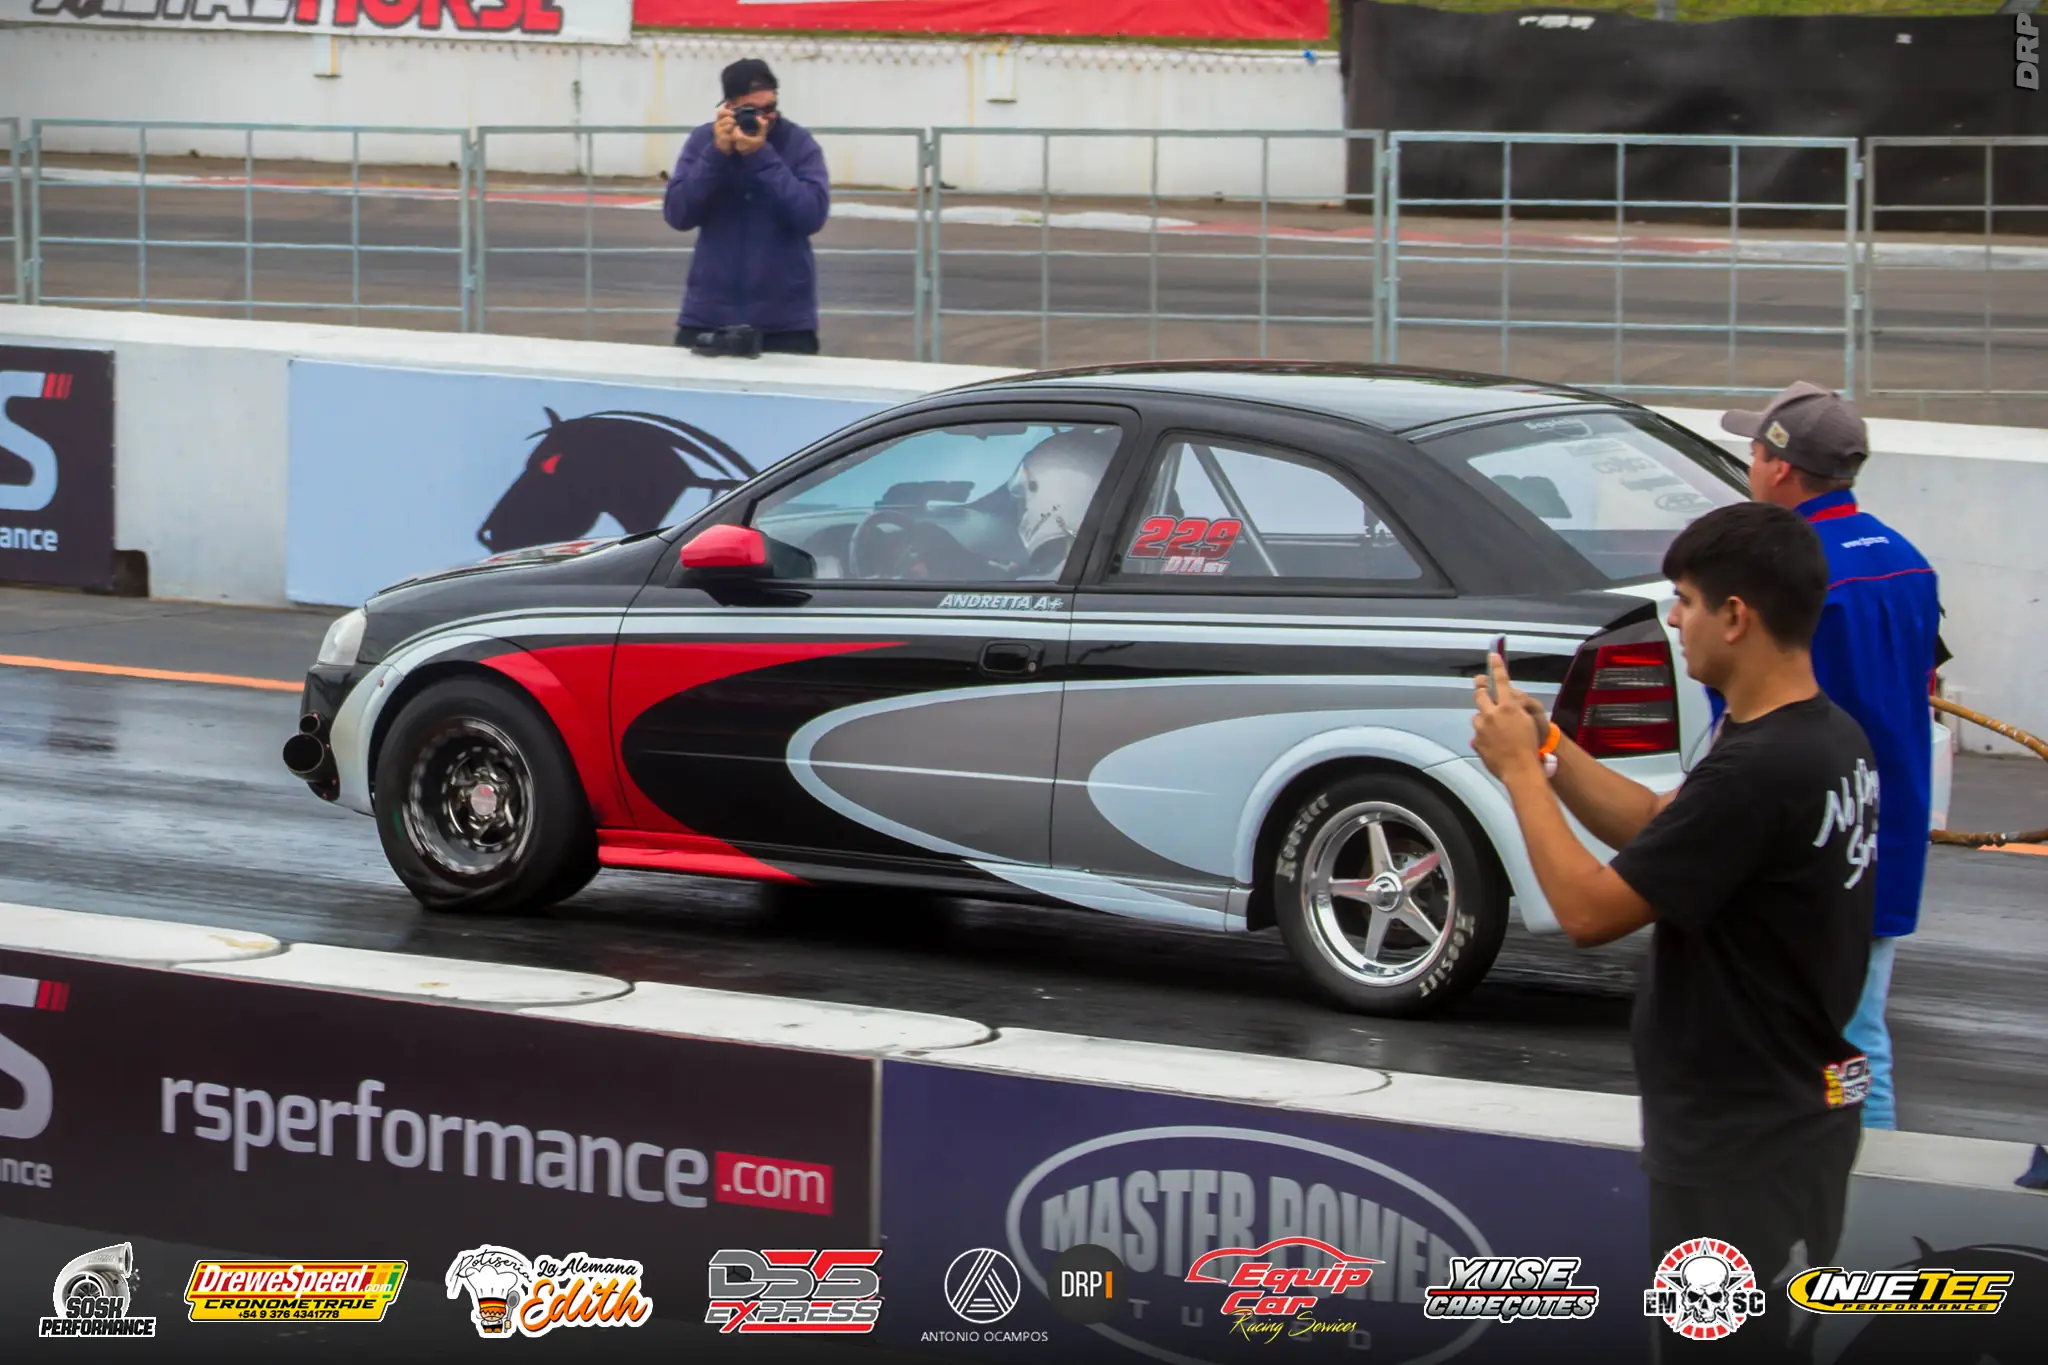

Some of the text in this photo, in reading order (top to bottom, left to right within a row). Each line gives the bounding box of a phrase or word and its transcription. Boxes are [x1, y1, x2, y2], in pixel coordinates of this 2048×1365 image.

[1126, 515, 1242, 560] 229
[937, 593, 1032, 609] ANDRETTA
[1042, 1169, 1257, 1284] MASTER
